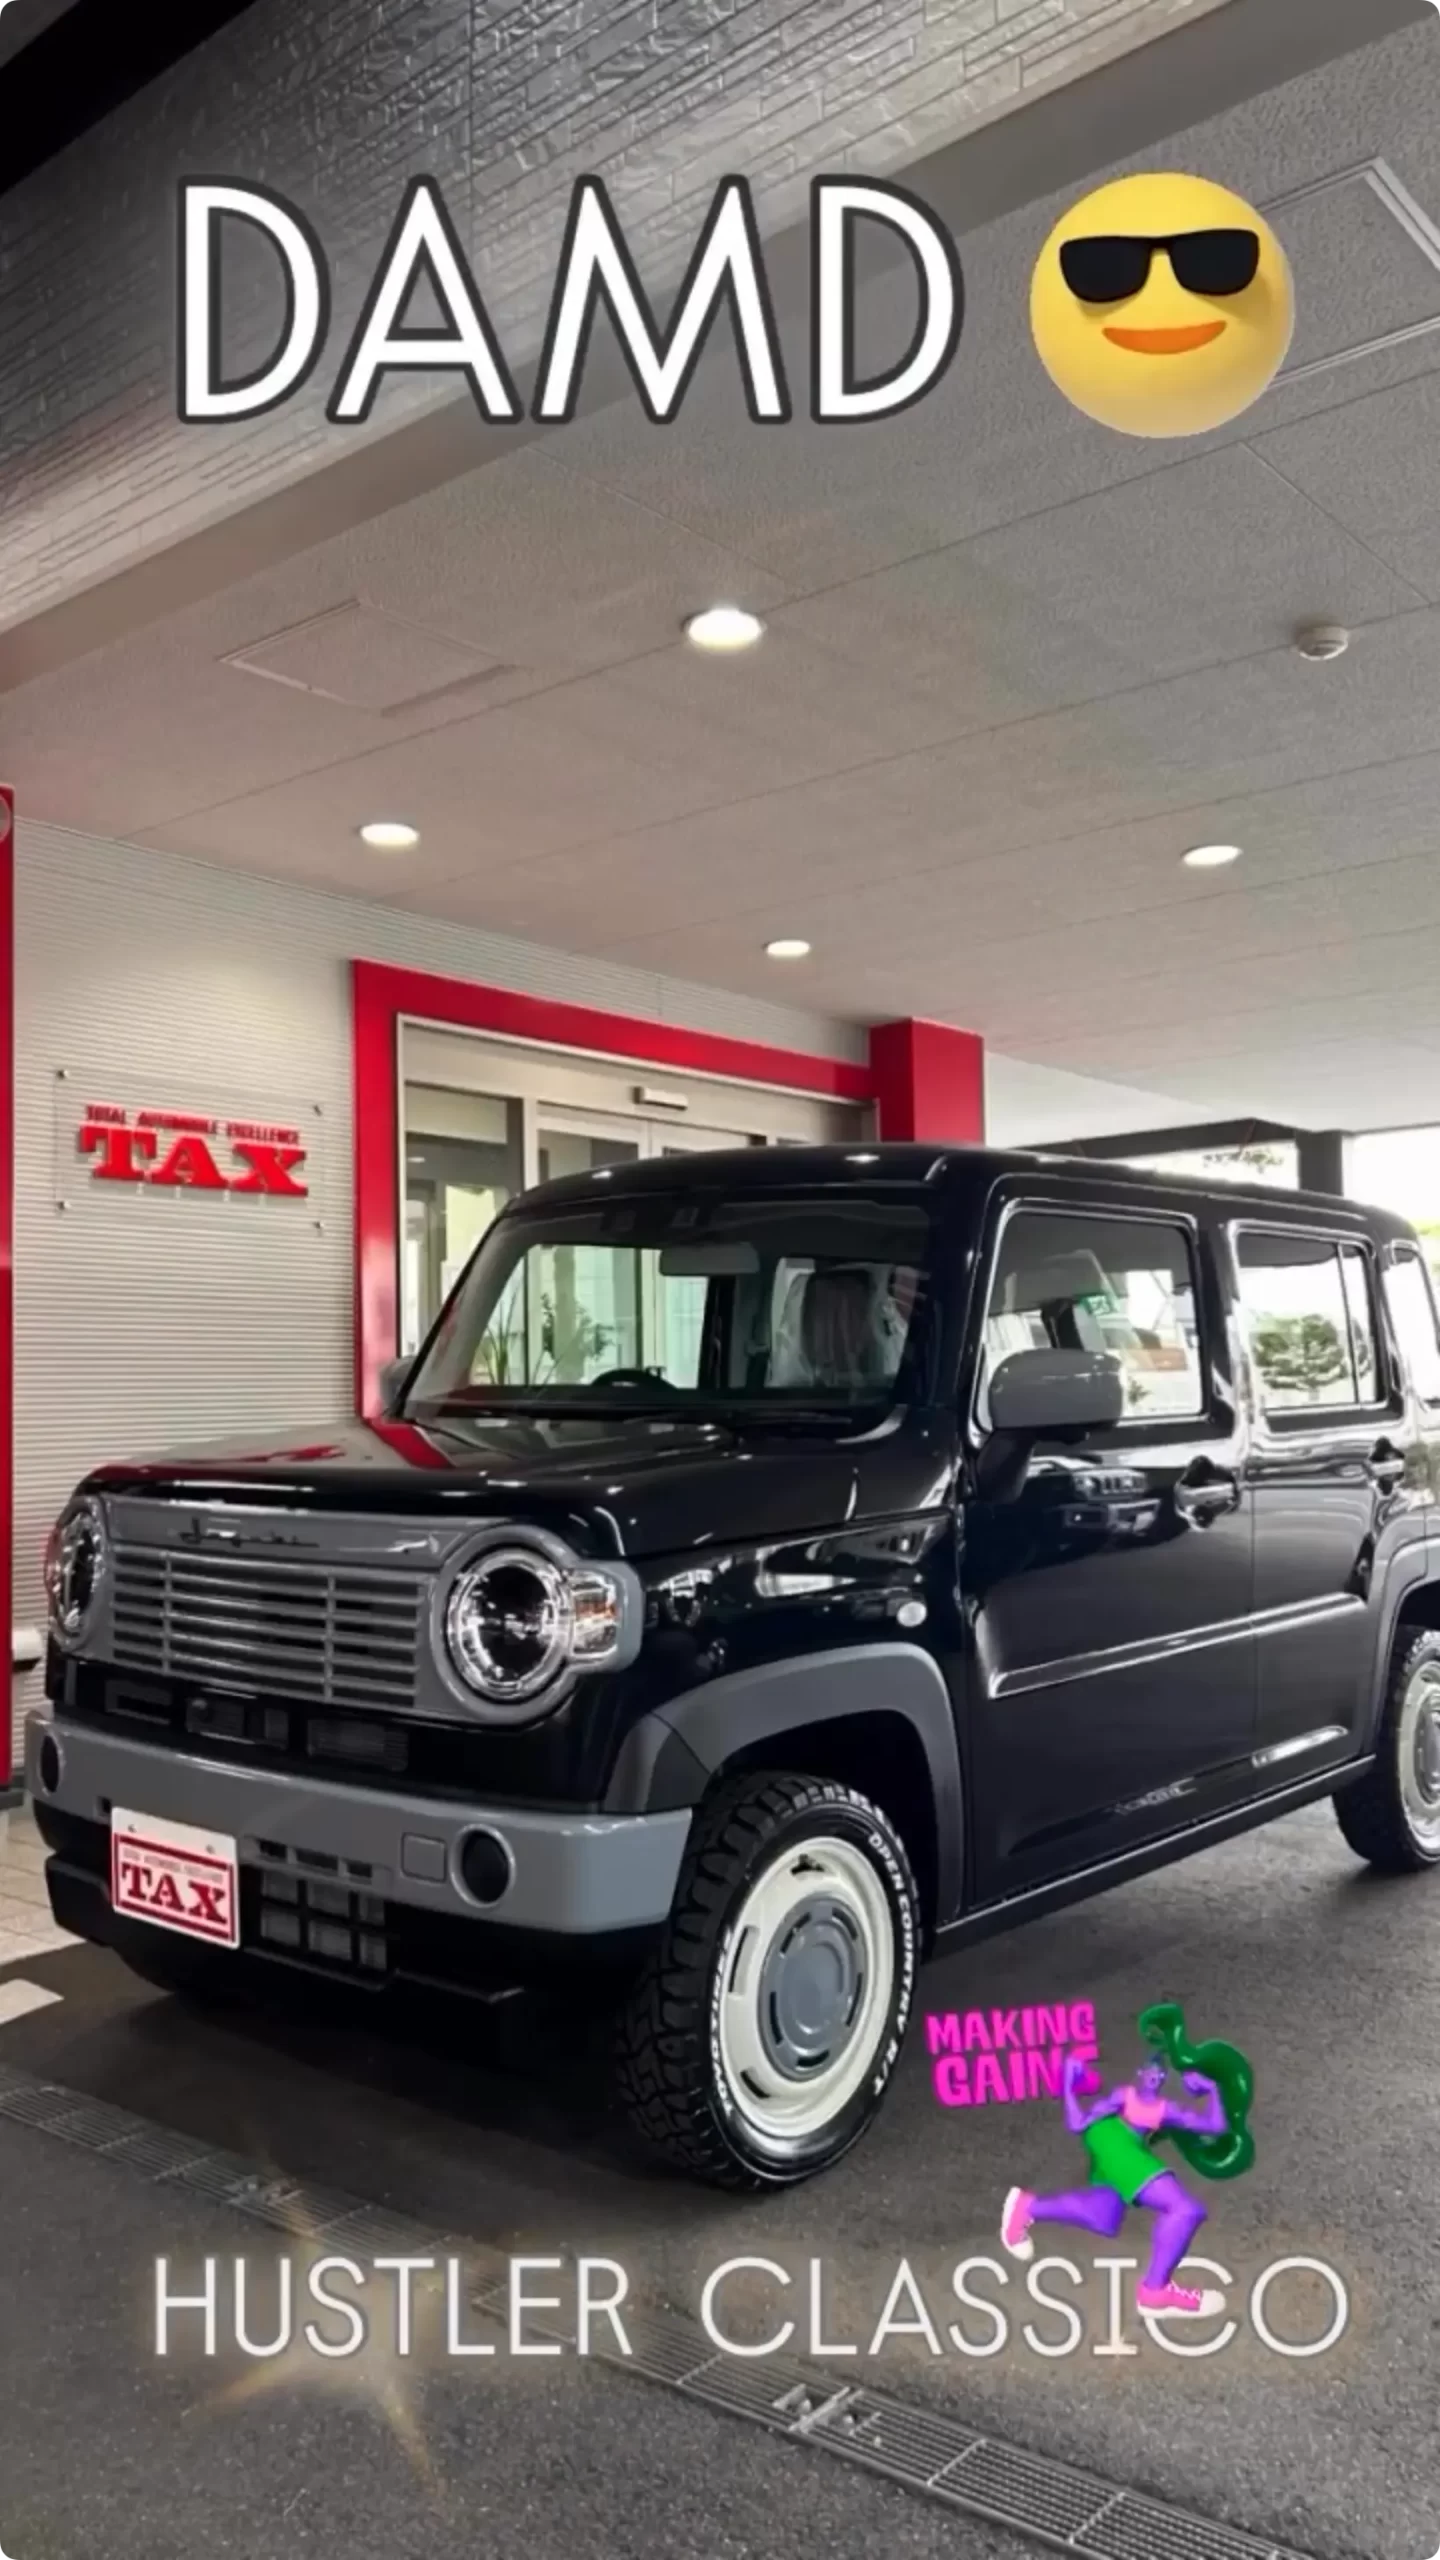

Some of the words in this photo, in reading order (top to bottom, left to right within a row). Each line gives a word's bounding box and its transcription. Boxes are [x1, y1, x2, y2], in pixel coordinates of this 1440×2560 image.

[80, 1125, 309, 1196] TAX
[121, 1861, 228, 1926] TAX
[868, 1831, 905, 1891] OPEN
[897, 1893, 914, 2034] COUNTRY
